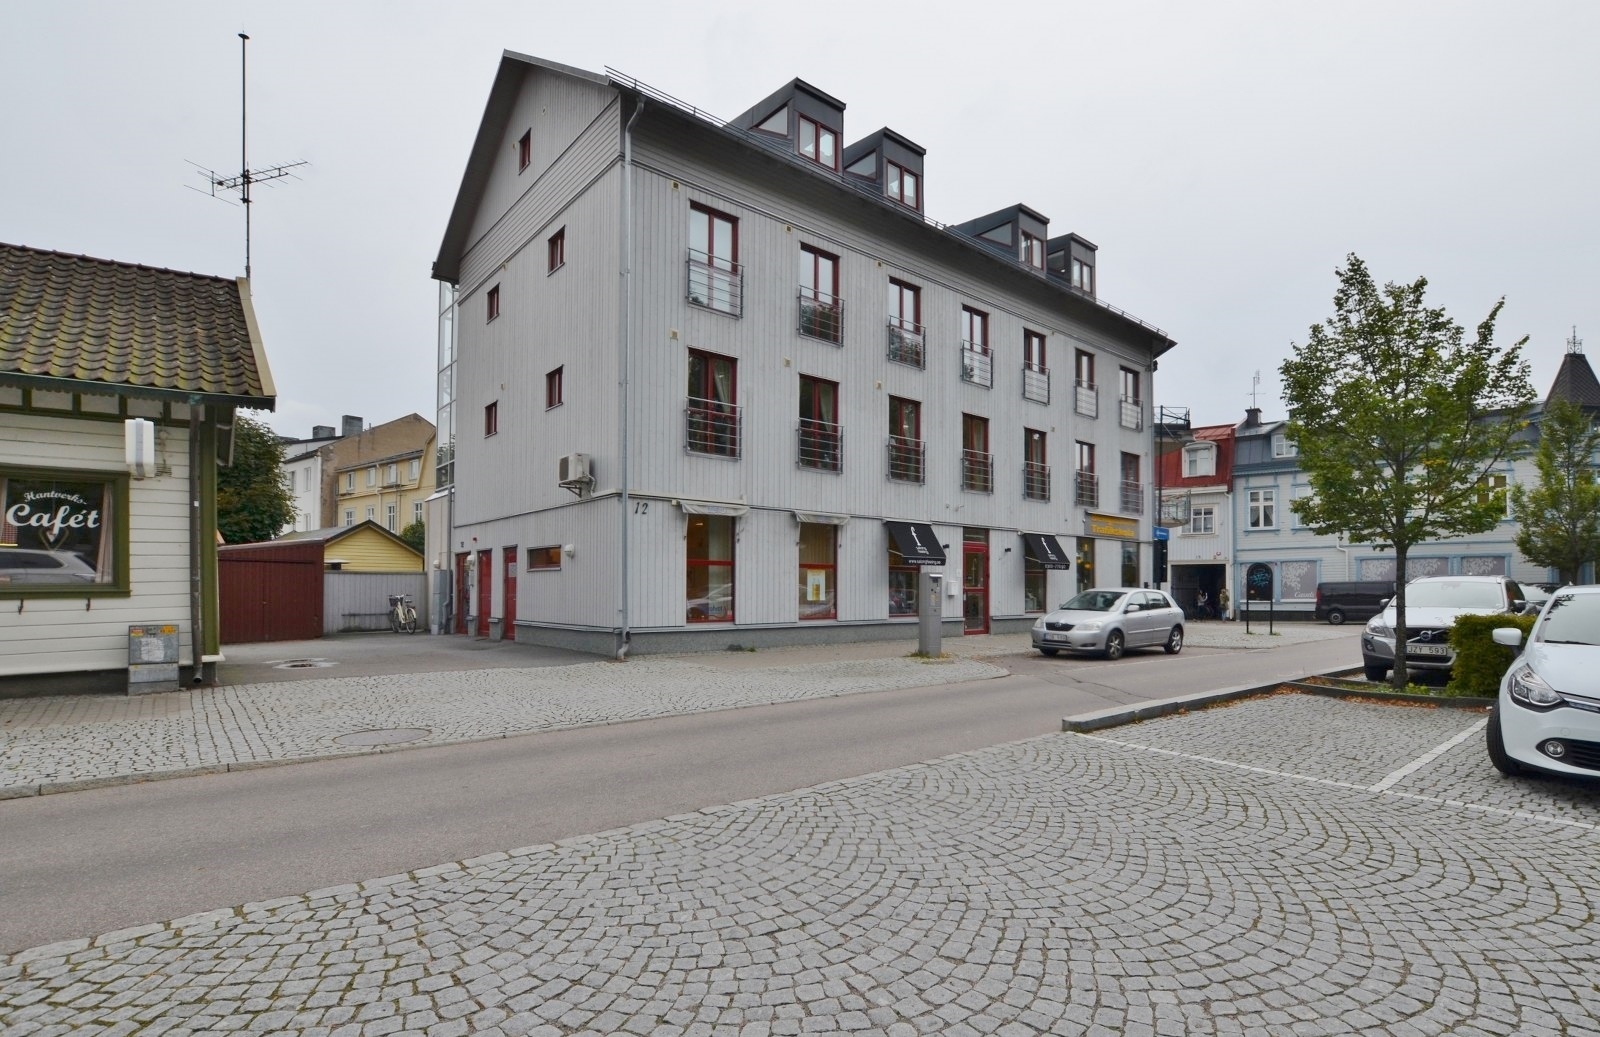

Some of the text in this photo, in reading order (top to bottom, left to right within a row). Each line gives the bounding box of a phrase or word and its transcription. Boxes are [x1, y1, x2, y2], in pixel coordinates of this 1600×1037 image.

[635, 502, 648, 514] 12
[6, 503, 100, 536] Cafét
[1429, 647, 1445, 655] 593
